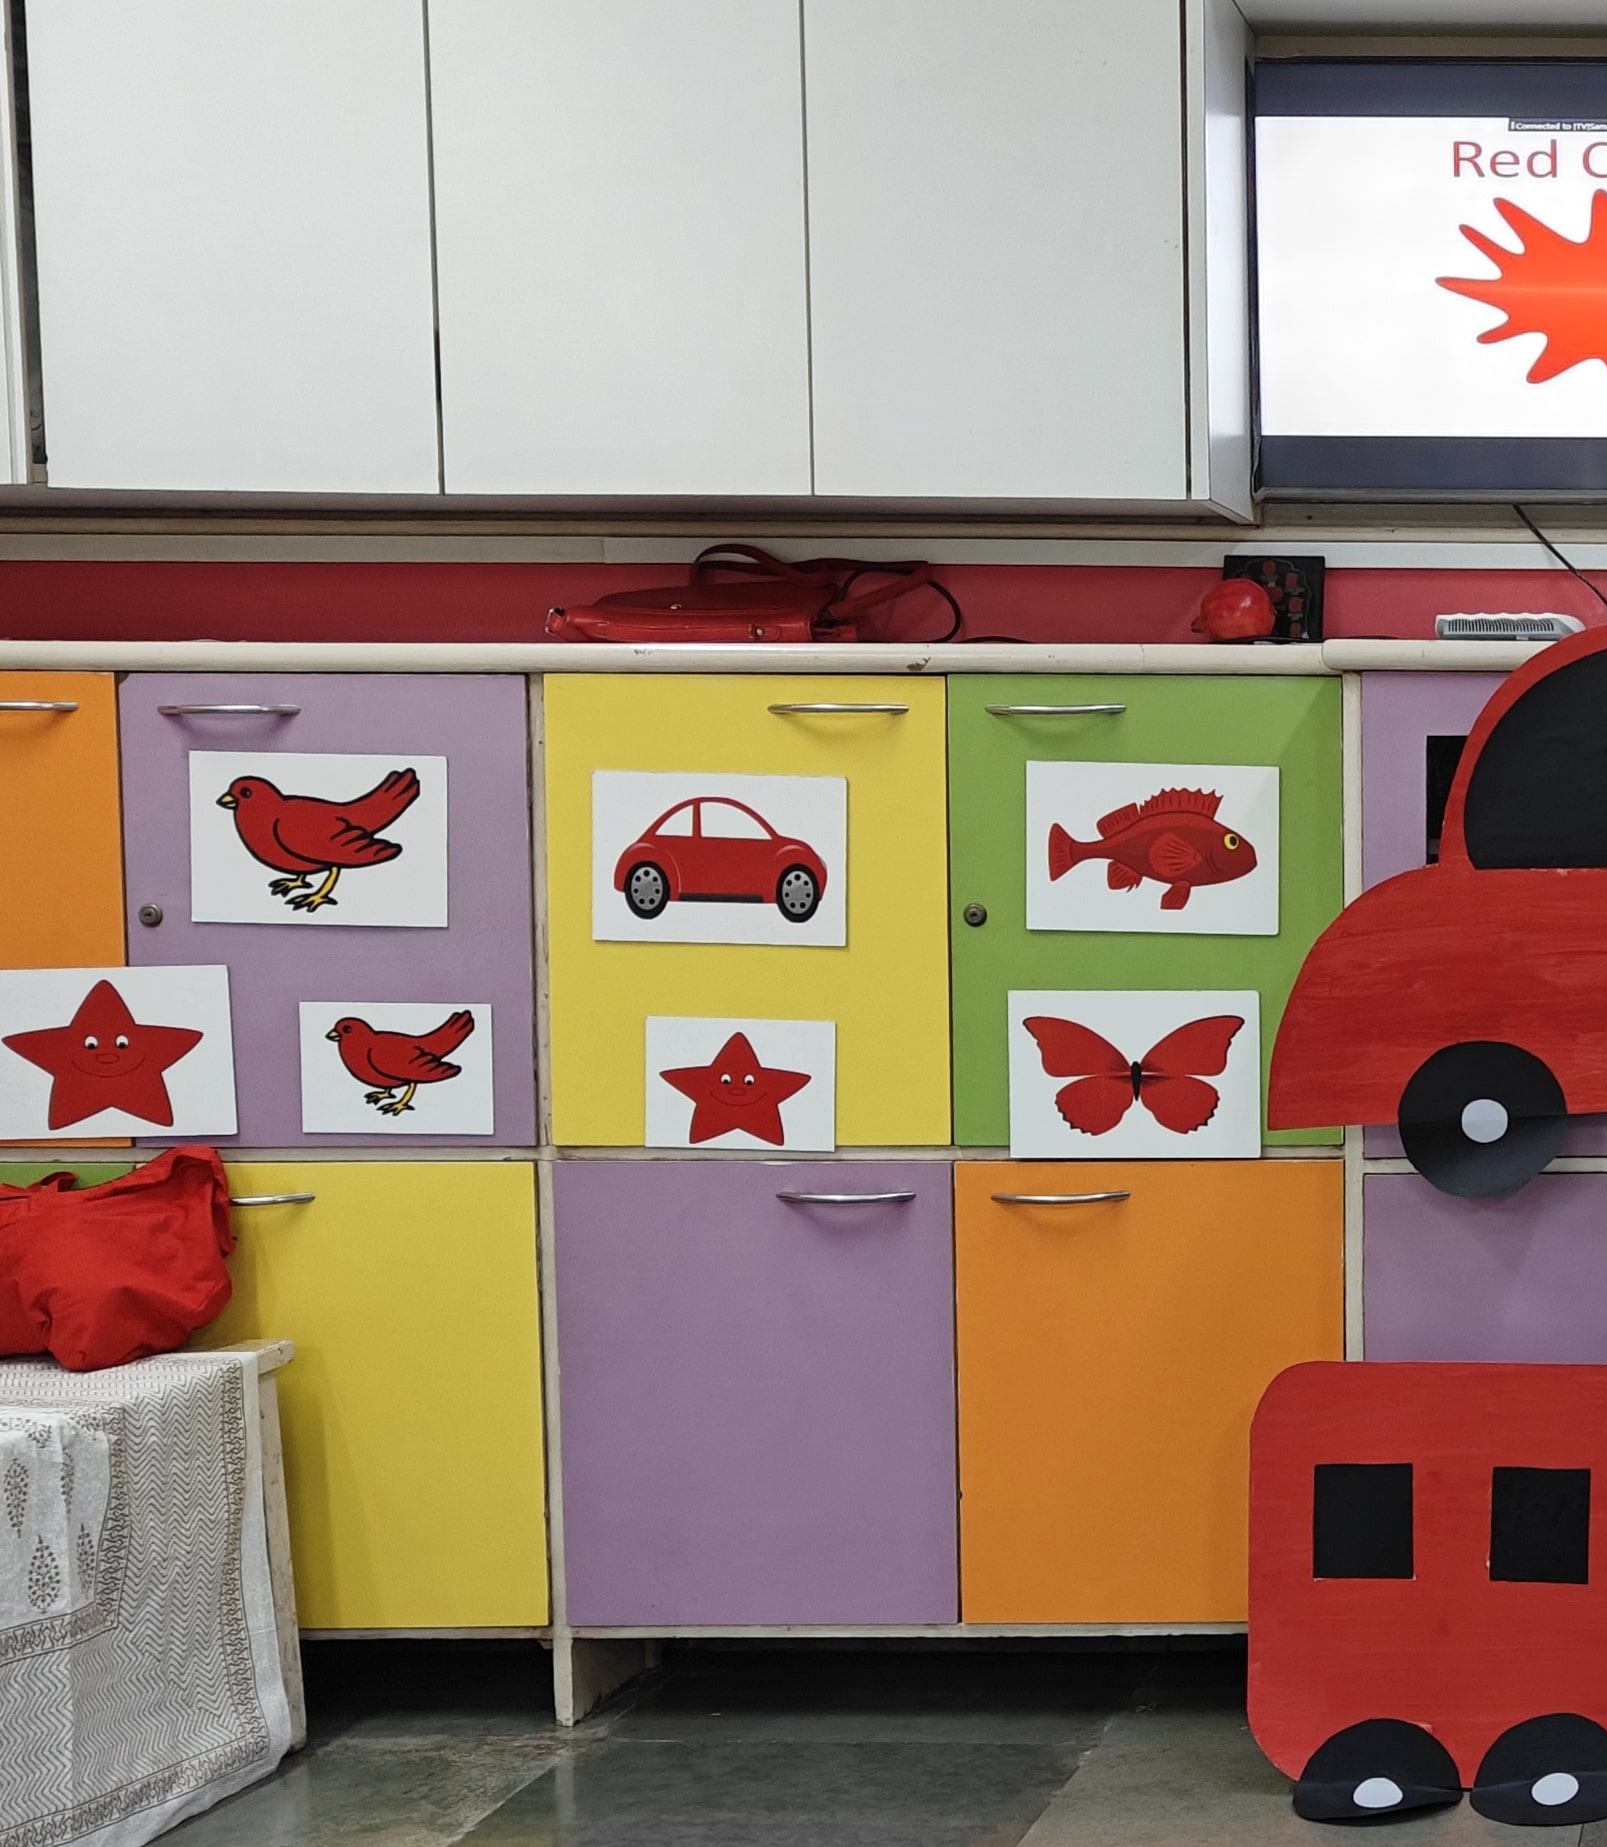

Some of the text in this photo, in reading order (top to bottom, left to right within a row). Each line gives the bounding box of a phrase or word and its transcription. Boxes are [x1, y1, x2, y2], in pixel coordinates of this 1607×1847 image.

[1516, 121, 1560, 130] Connected
[1562, 122, 1572, 130] to
[1453, 139, 1557, 178] Red
